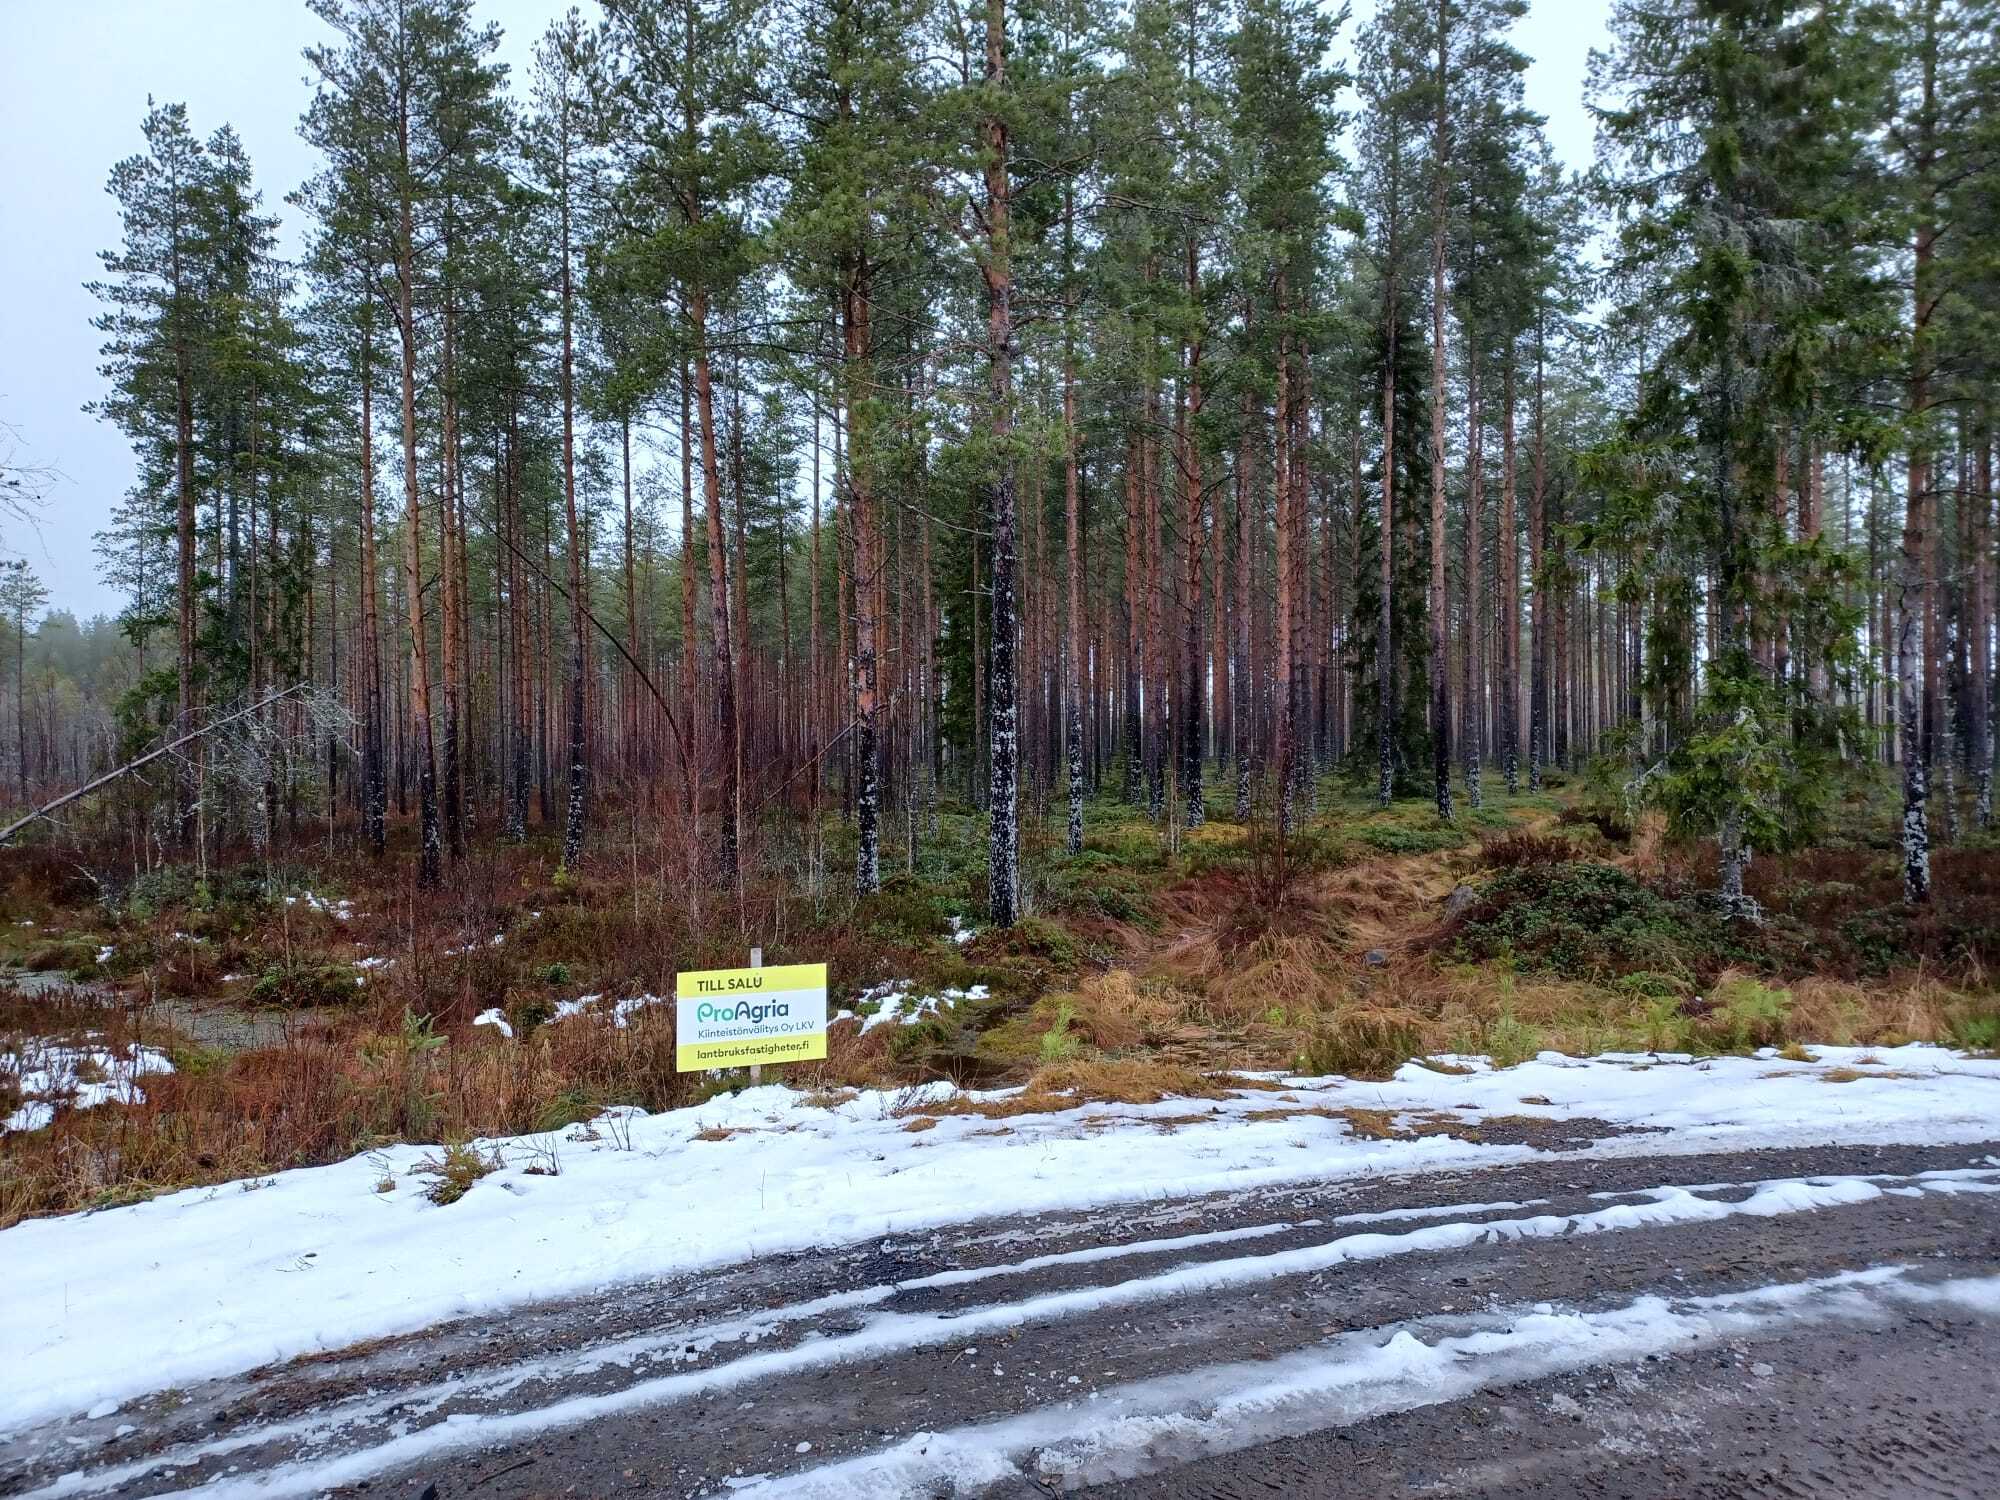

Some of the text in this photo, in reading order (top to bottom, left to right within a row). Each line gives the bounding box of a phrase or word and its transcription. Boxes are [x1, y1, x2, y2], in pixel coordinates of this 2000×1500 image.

[697, 977, 762, 992] TILL SALU
[697, 999, 789, 1023] ProAgria
[698, 1021, 815, 1039] Kiinteistönvälitys Oy LKV
[697, 1040, 809, 1060] lantbruksfastigheter.fi
